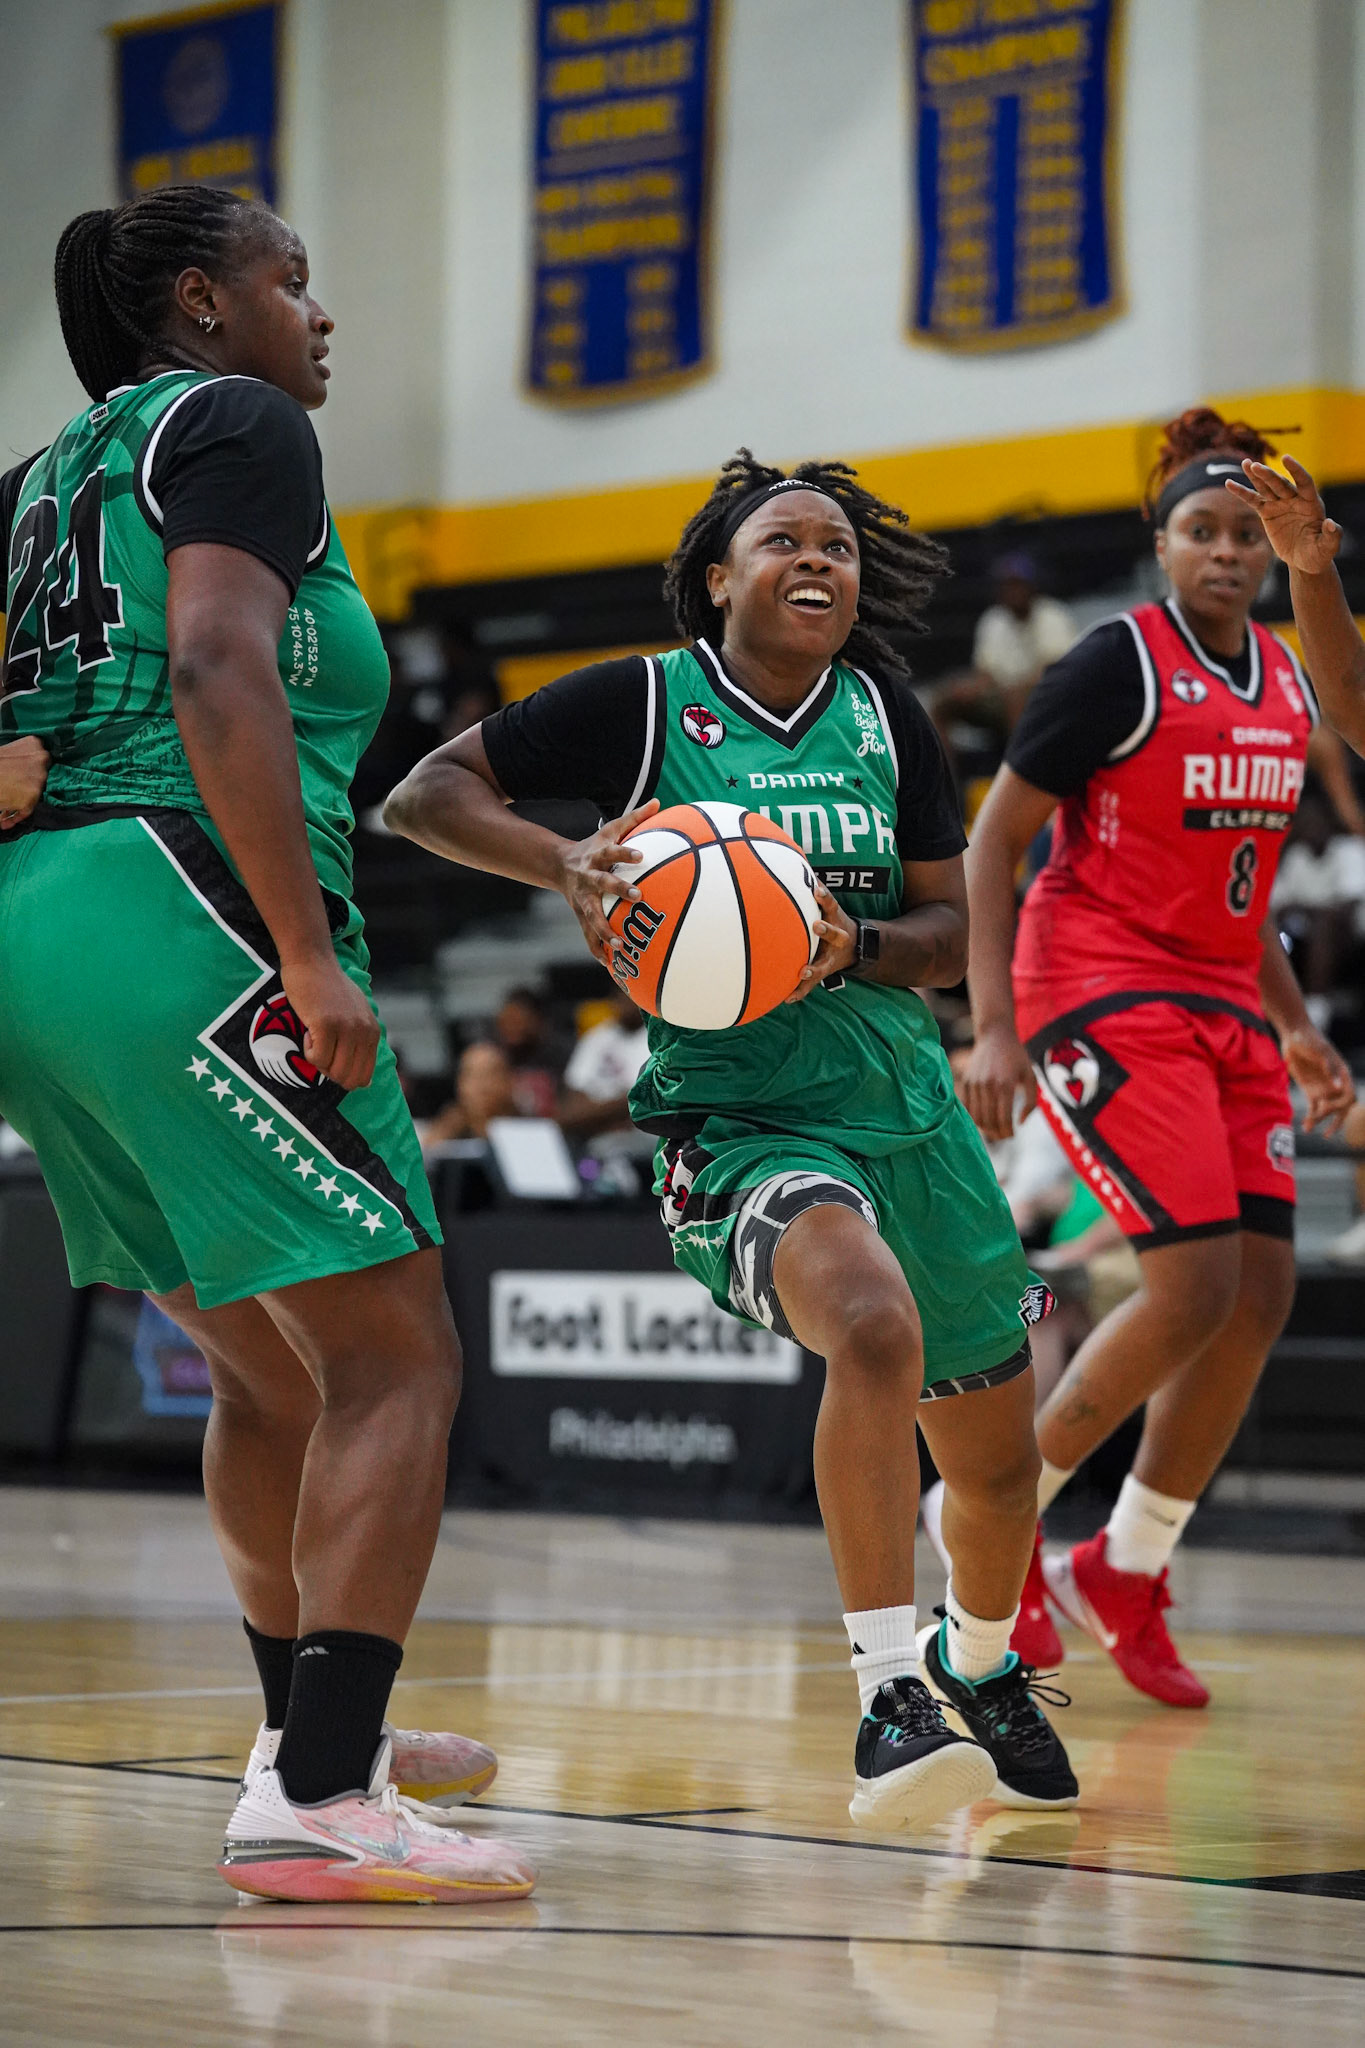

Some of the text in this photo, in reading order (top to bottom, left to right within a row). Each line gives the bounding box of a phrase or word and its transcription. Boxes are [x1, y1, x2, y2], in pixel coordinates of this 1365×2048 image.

[0, 463, 126, 704] 24
[748, 772, 844, 789] DANNY
[759, 803, 896, 855] MPH
[1225, 836, 1257, 917] 8
